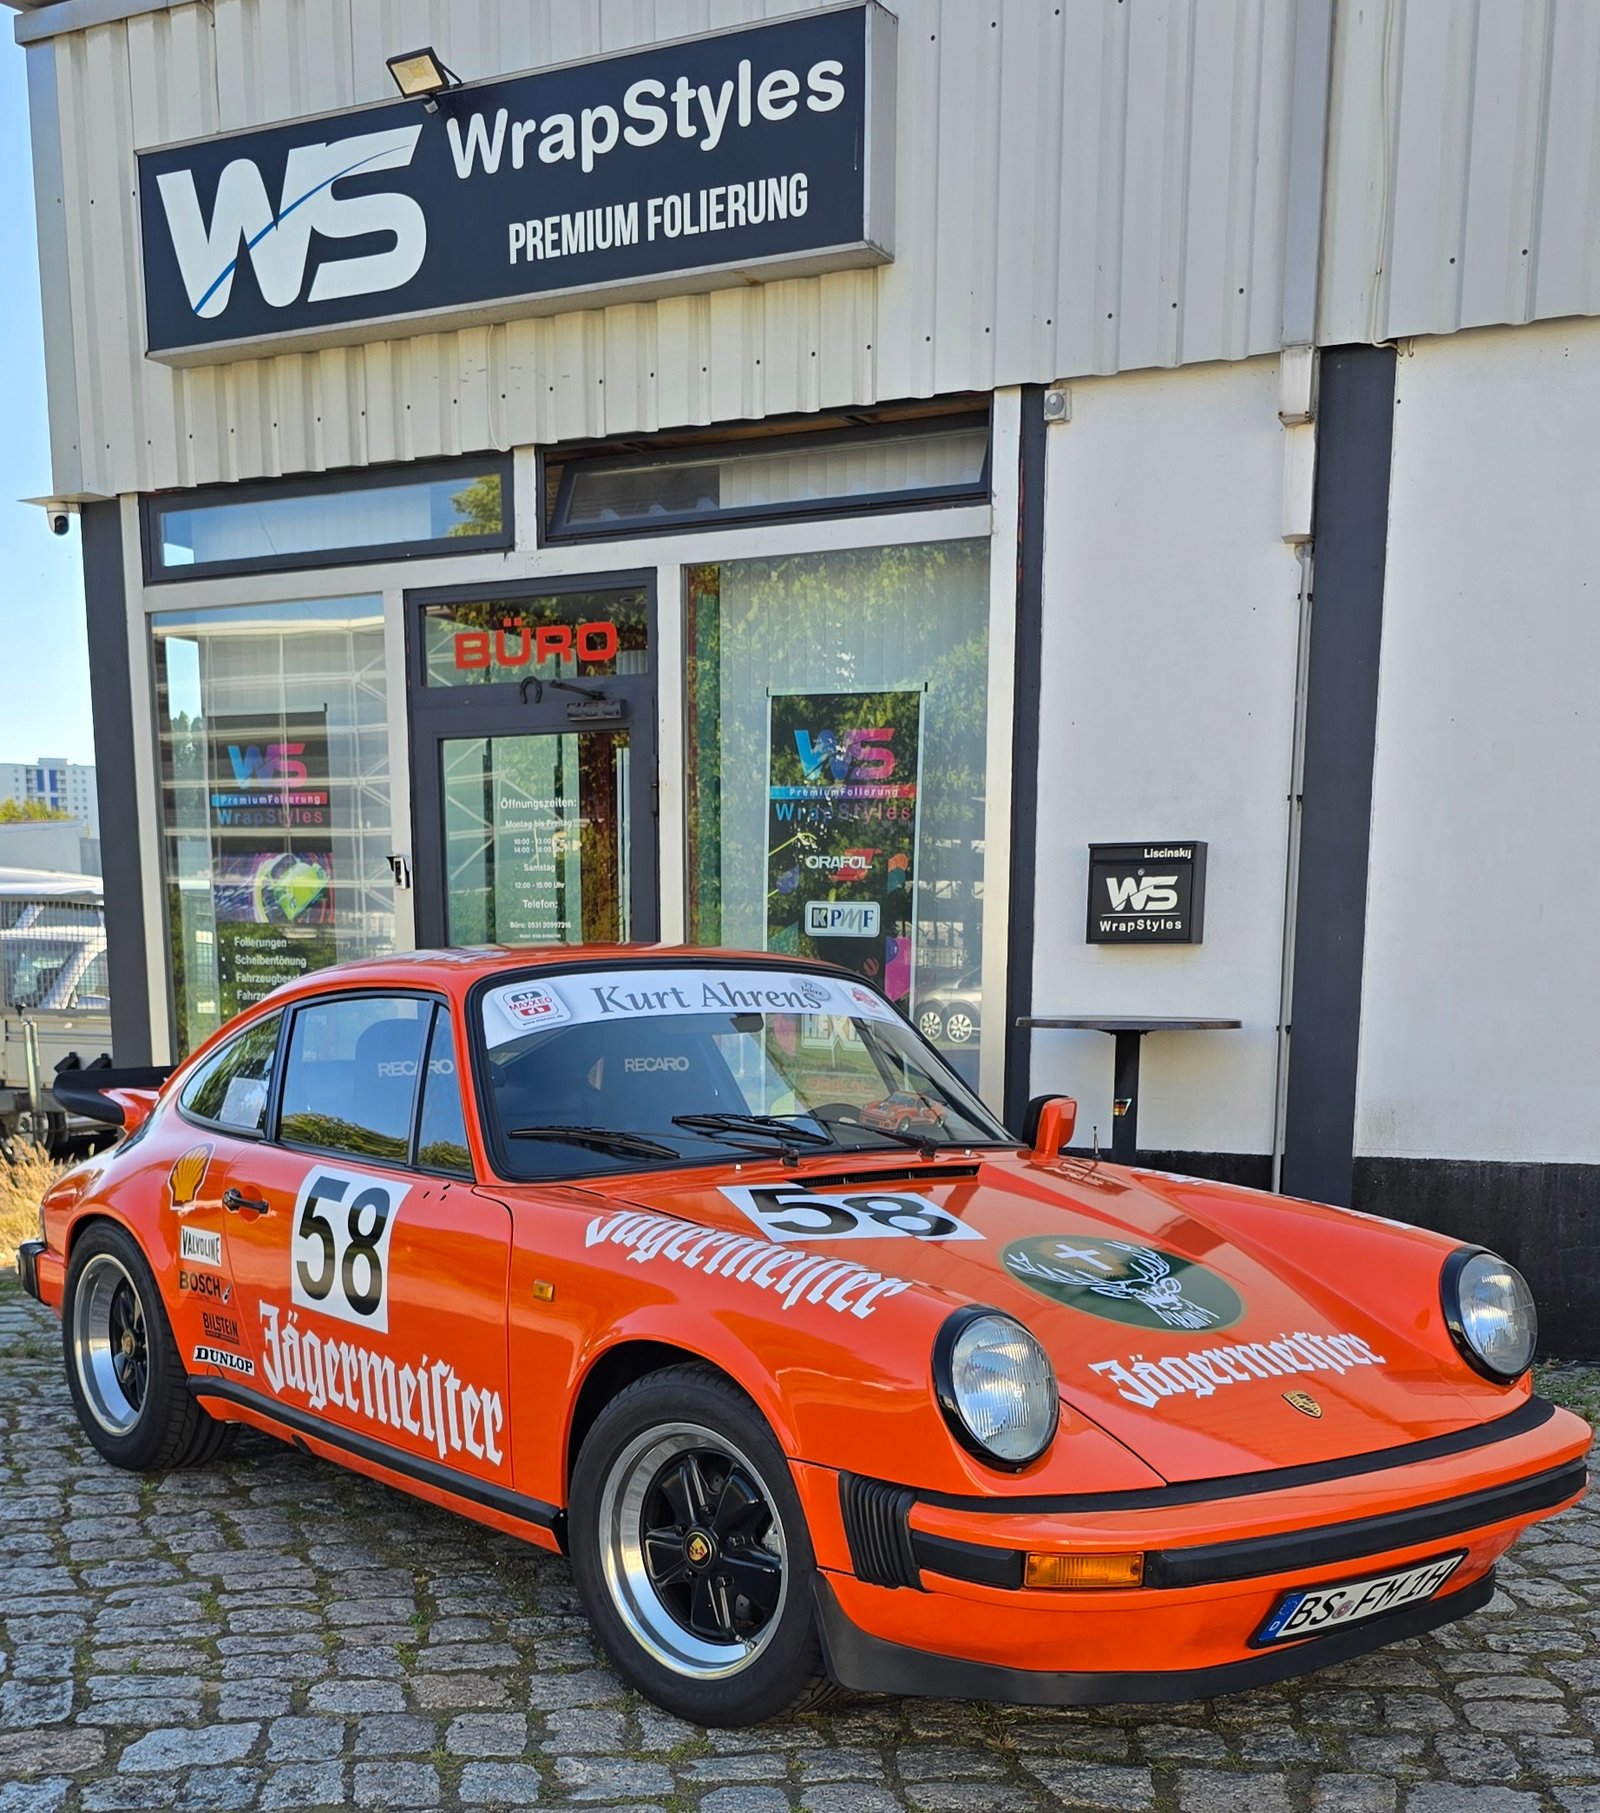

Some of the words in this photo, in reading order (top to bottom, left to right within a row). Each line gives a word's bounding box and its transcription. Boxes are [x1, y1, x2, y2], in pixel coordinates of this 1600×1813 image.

[446, 58, 846, 180] WrapStyles
[155, 123, 427, 319] WS
[508, 199, 639, 264] PREMIUM
[646, 172, 809, 242] FOLIERUNG
[454, 617, 619, 670] BÜRO
[227, 743, 307, 790] WS
[793, 727, 896, 780] WS
[805, 855, 873, 870] ORAFOL
[522, 899, 559, 909] Telefon:
[1105, 875, 1178, 911] WS
[233, 936, 287, 950] Folierungen
[1099, 918, 1182, 933] WrapStyles
[590, 984, 691, 1015] Kurt
[700, 981, 822, 1011] Ahrens
[377, 1058, 455, 1078] RECRO
[624, 1056, 690, 1073] RECARO
[748, 1187, 959, 1237] 58
[181, 1228, 221, 1265] VALVOLINE
[296, 1175, 391, 1317] 58
[179, 1270, 222, 1299] BOSCH
[202, 1312, 239, 1339] BILSTEIN
[195, 1346, 253, 1374] DUNLOP
[1282, 1591, 1347, 1631] BS
